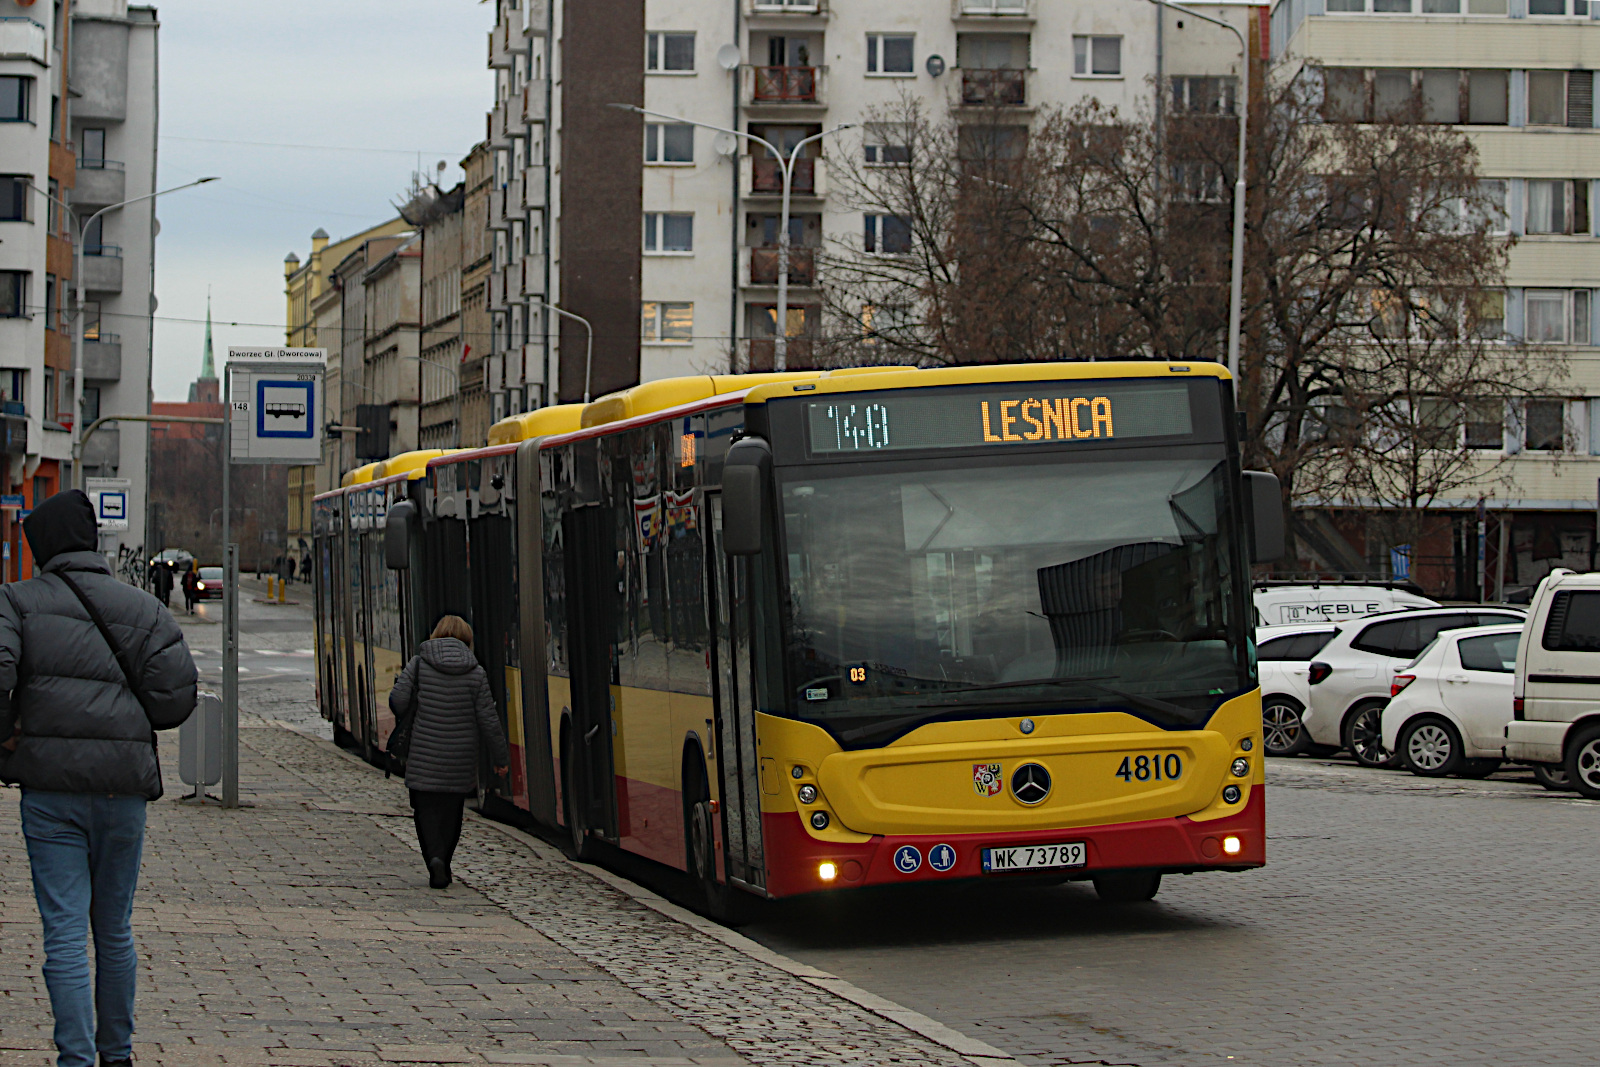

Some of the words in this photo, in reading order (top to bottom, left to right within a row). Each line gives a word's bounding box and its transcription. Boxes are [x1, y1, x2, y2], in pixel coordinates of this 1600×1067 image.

[229, 350, 262, 358] Dworzec
[277, 350, 322, 359] (Dworcowa)
[981, 396, 1113, 442] LEŚNICA
[1306, 603, 1380, 614] MEBLE
[850, 667, 866, 682] 03
[1115, 753, 1183, 782] 4810
[995, 849, 1018, 868] WK
[1025, 845, 1081, 866] 73789
